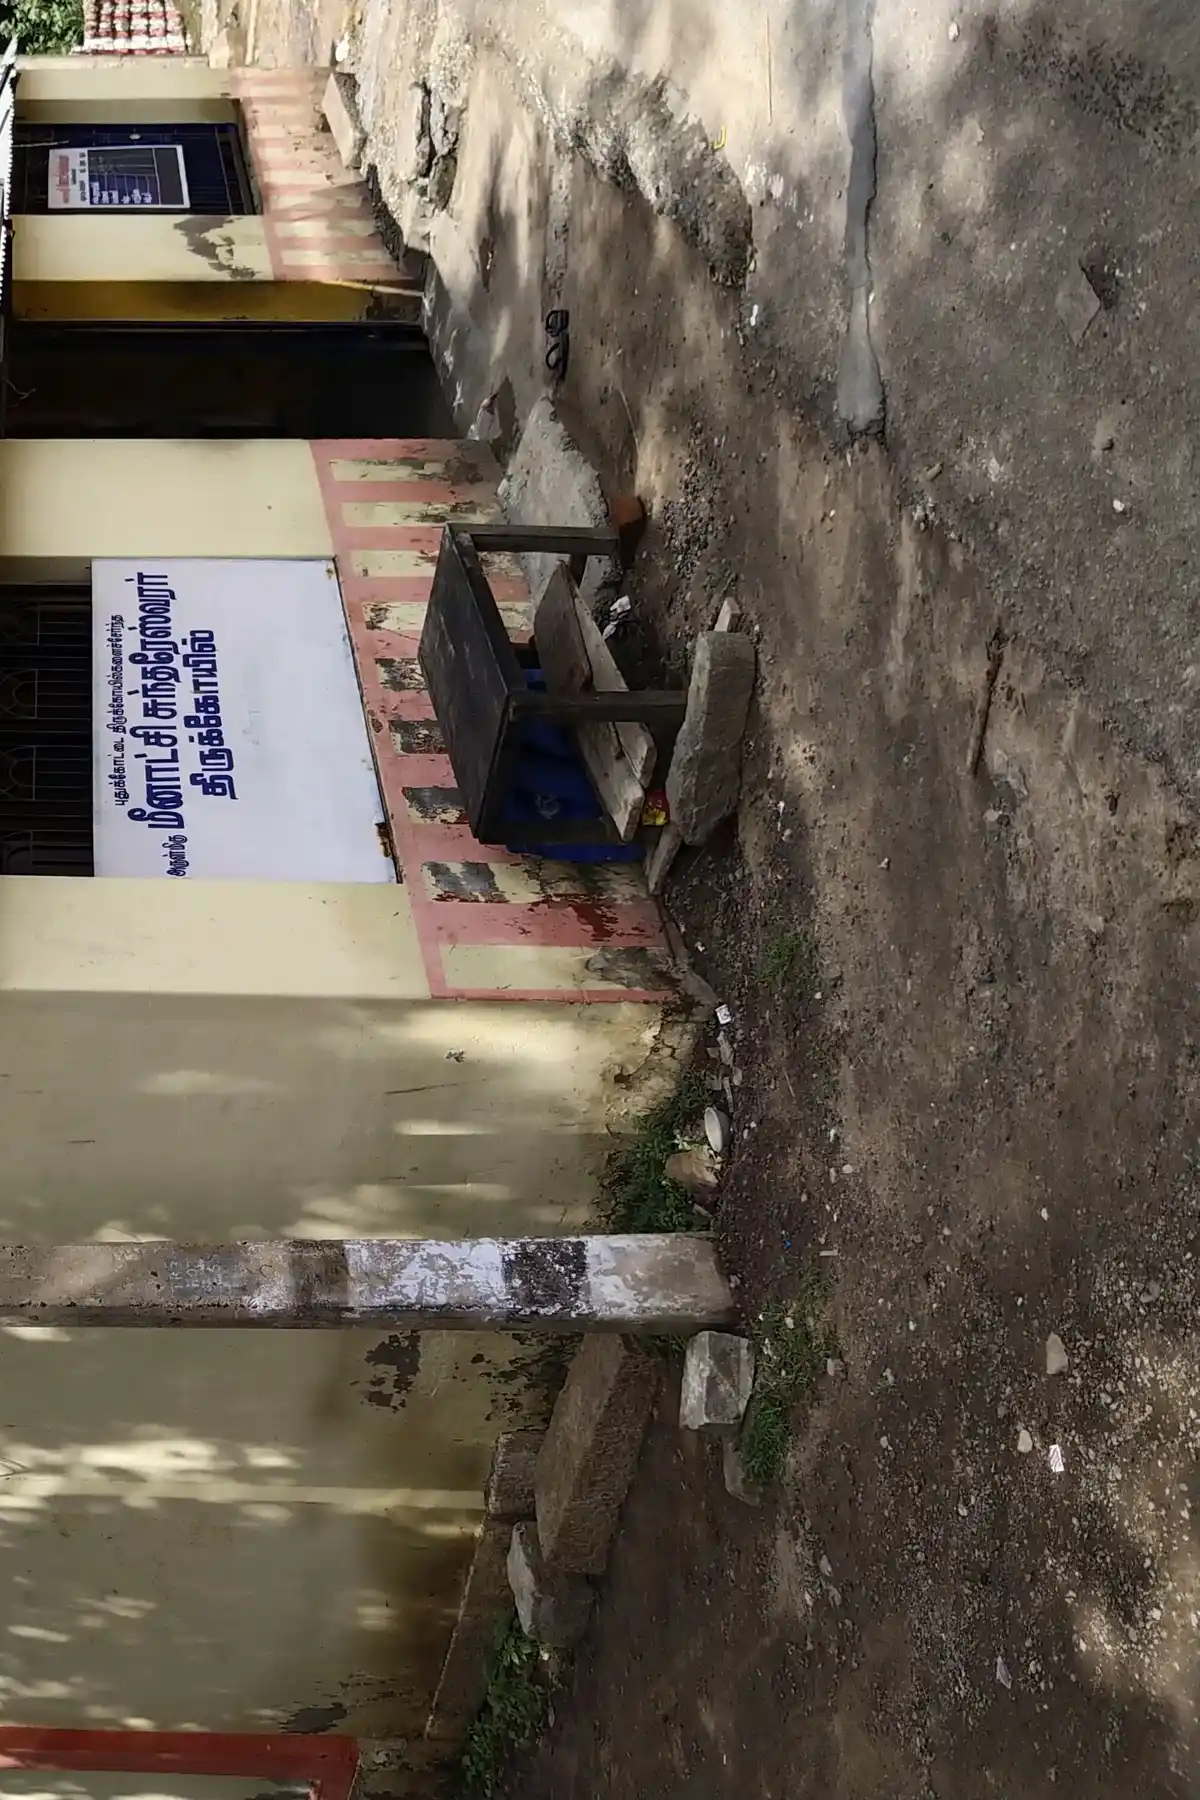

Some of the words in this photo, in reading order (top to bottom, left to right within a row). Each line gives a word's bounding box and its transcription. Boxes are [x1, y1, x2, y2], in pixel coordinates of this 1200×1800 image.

[125, 572, 180, 719] சுந்தரேஸ்வரர்
[181, 630, 237, 799] திருக்கோயில்
[109, 738, 129, 806] புதுக்கோட்டை
[128, 726, 184, 829] மீனாட்சி
[162, 835, 188, 876] அருள்மிகு
